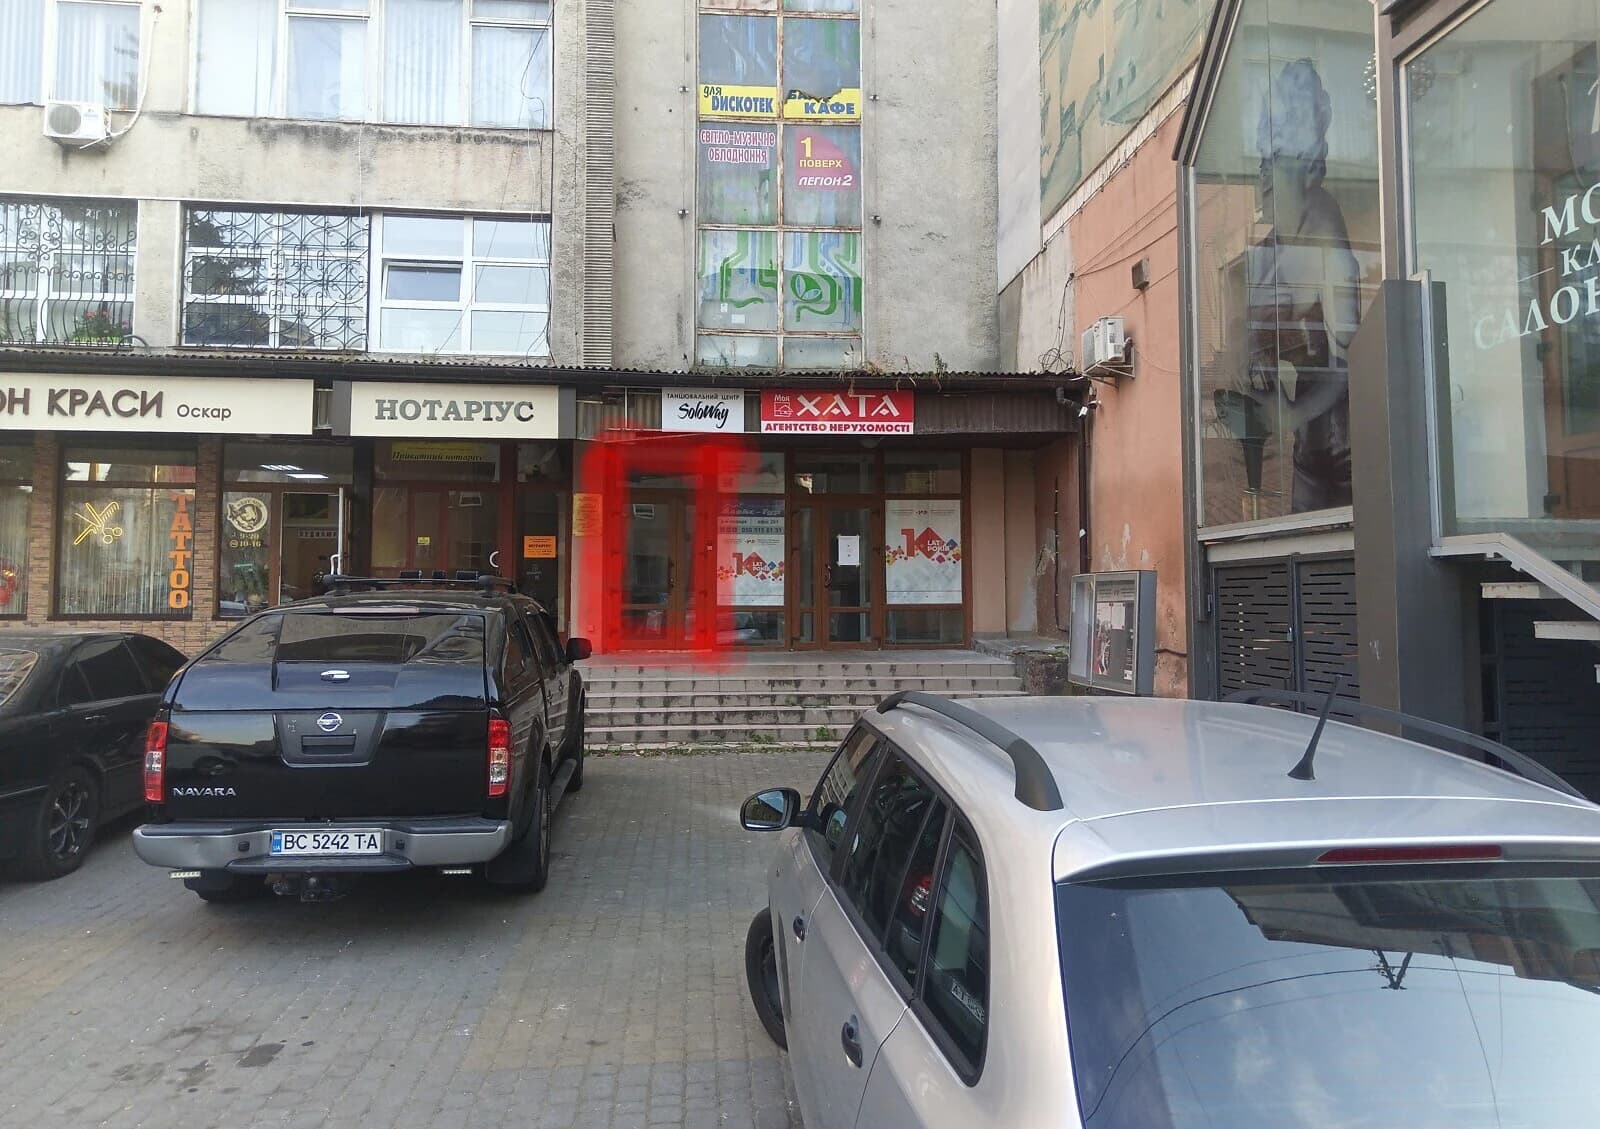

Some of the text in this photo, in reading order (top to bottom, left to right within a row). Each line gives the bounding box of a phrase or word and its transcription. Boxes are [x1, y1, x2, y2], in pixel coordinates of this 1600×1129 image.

[711, 96, 774, 113] ДИСКОТЕК
[804, 102, 855, 114] КАФЕ
[800, 136, 812, 158] 1
[799, 159, 843, 168] ПОВЕРХ
[0, 387, 232, 421] Н КРАСИ Оскар
[774, 394, 790, 402] Моя
[796, 394, 900, 417] ХАТА
[375, 399, 534, 422] НОТАРІУС
[764, 423, 910, 433] АГЕНТСТВО НЕРУХОМОСТІ
[168, 494, 192, 609] TATTOO
[173, 787, 237, 796] NAVARA
[284, 834, 378, 850] BC 5242 TA
